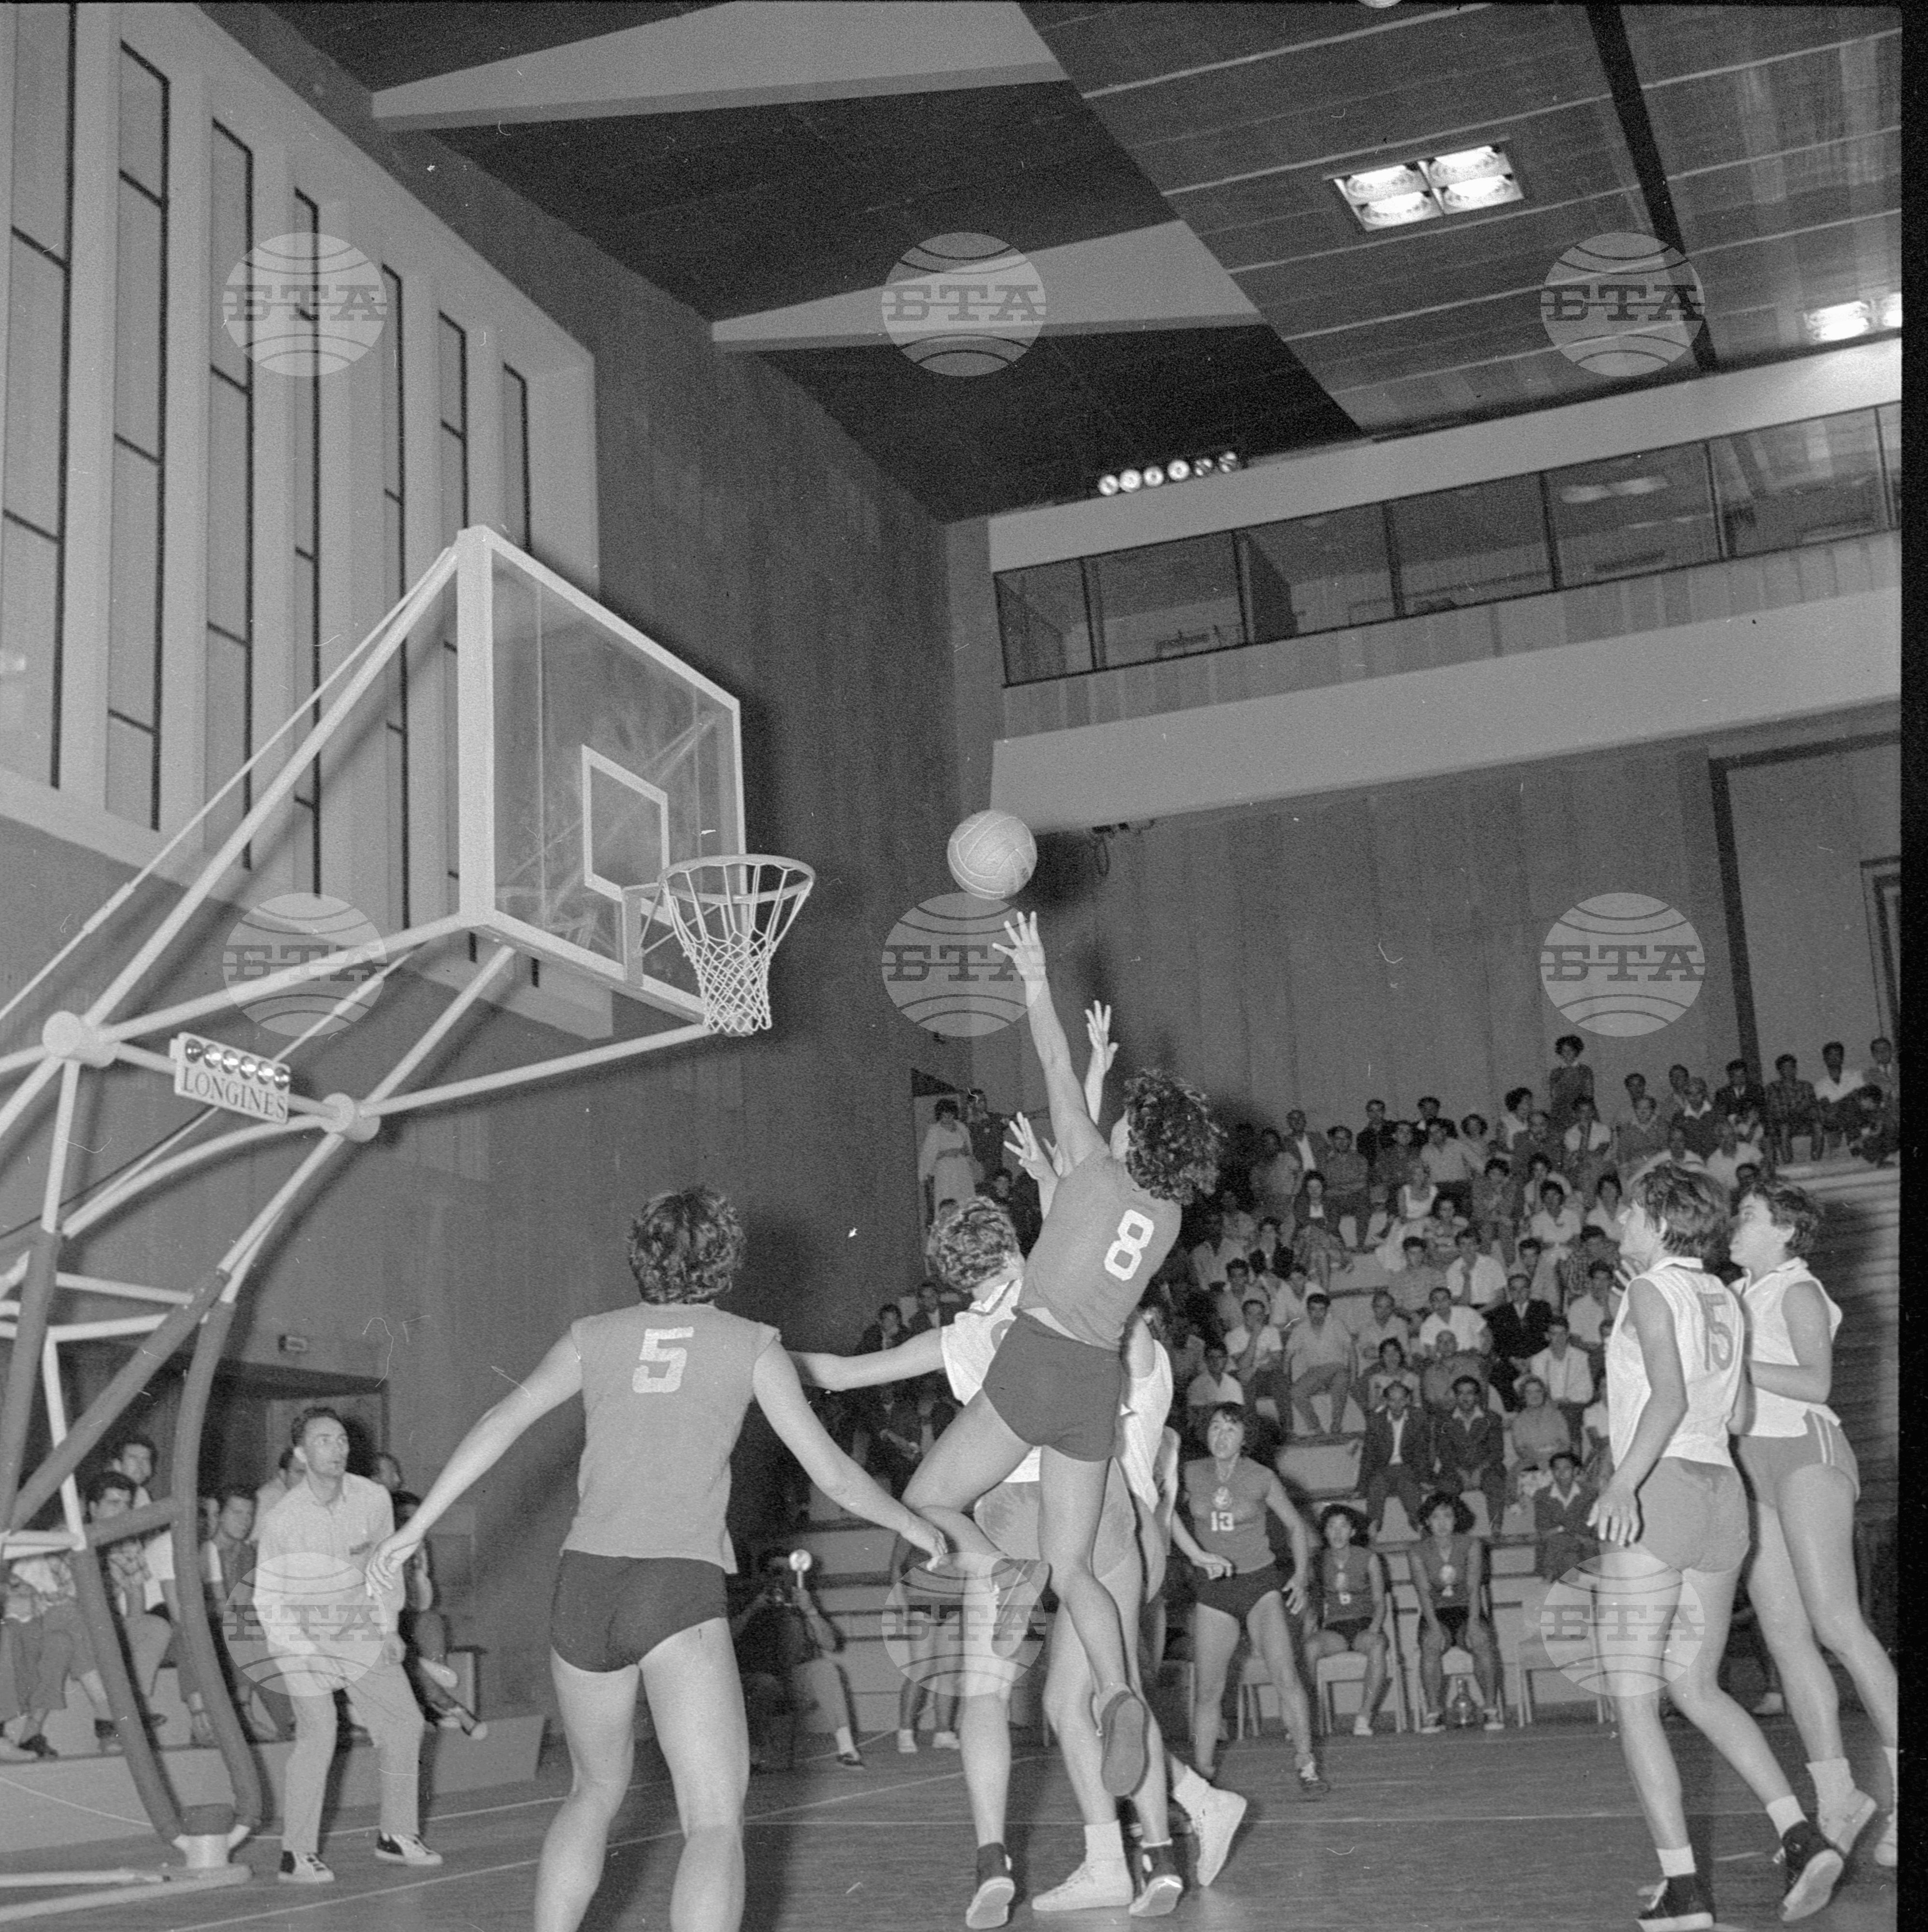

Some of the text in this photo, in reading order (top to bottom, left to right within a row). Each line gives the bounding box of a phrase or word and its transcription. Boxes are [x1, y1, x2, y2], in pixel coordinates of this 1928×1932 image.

[184, 1066, 286, 1120] LONGINES
[1104, 1209, 1154, 1281] 8
[632, 1326, 694, 1394] 5
[1211, 1511, 1234, 1531] 13
